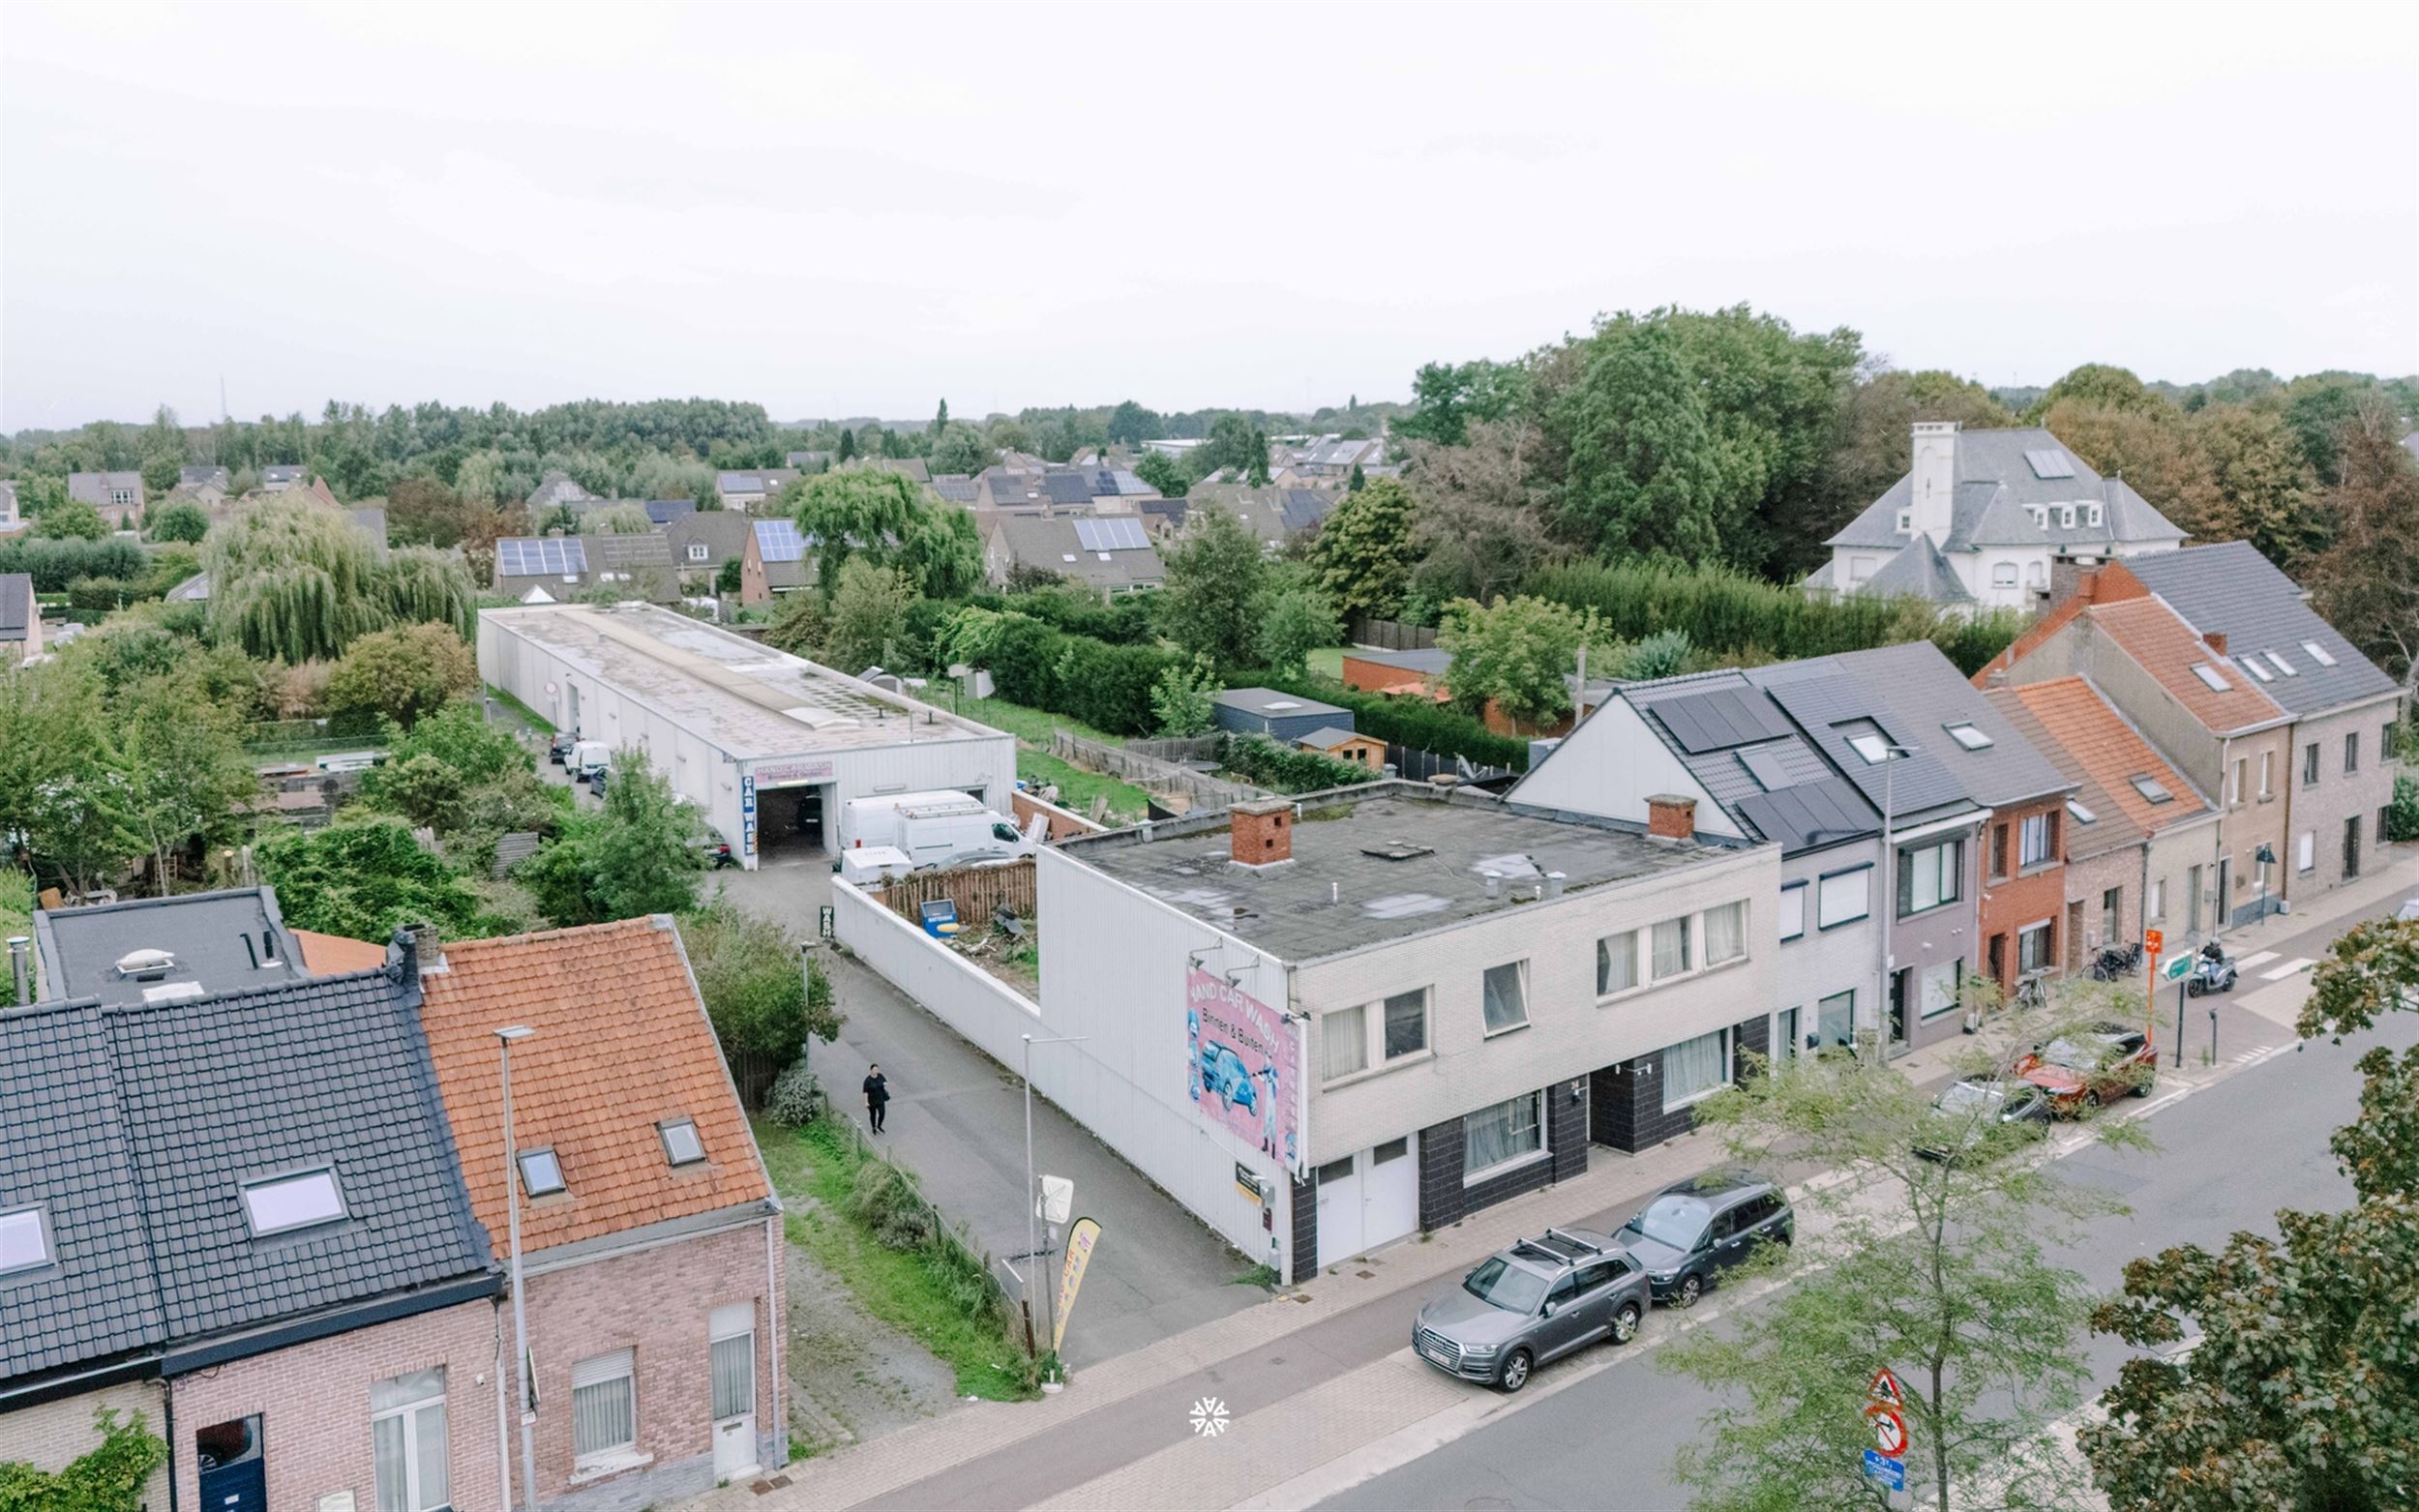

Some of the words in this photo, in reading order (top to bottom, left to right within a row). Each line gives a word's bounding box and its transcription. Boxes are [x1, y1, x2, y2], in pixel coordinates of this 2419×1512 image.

[744, 777, 753, 807] CAR
[822, 907, 832, 937] WASH
[1190, 982, 1216, 1002] HAND
[1219, 985, 1244, 1013] CAR
[1245, 999, 1280, 1053] WASH
[1202, 1006, 1229, 1034] Binnen
[1230, 1023, 1237, 1039] &
[1238, 1027, 1265, 1054] Buiten
